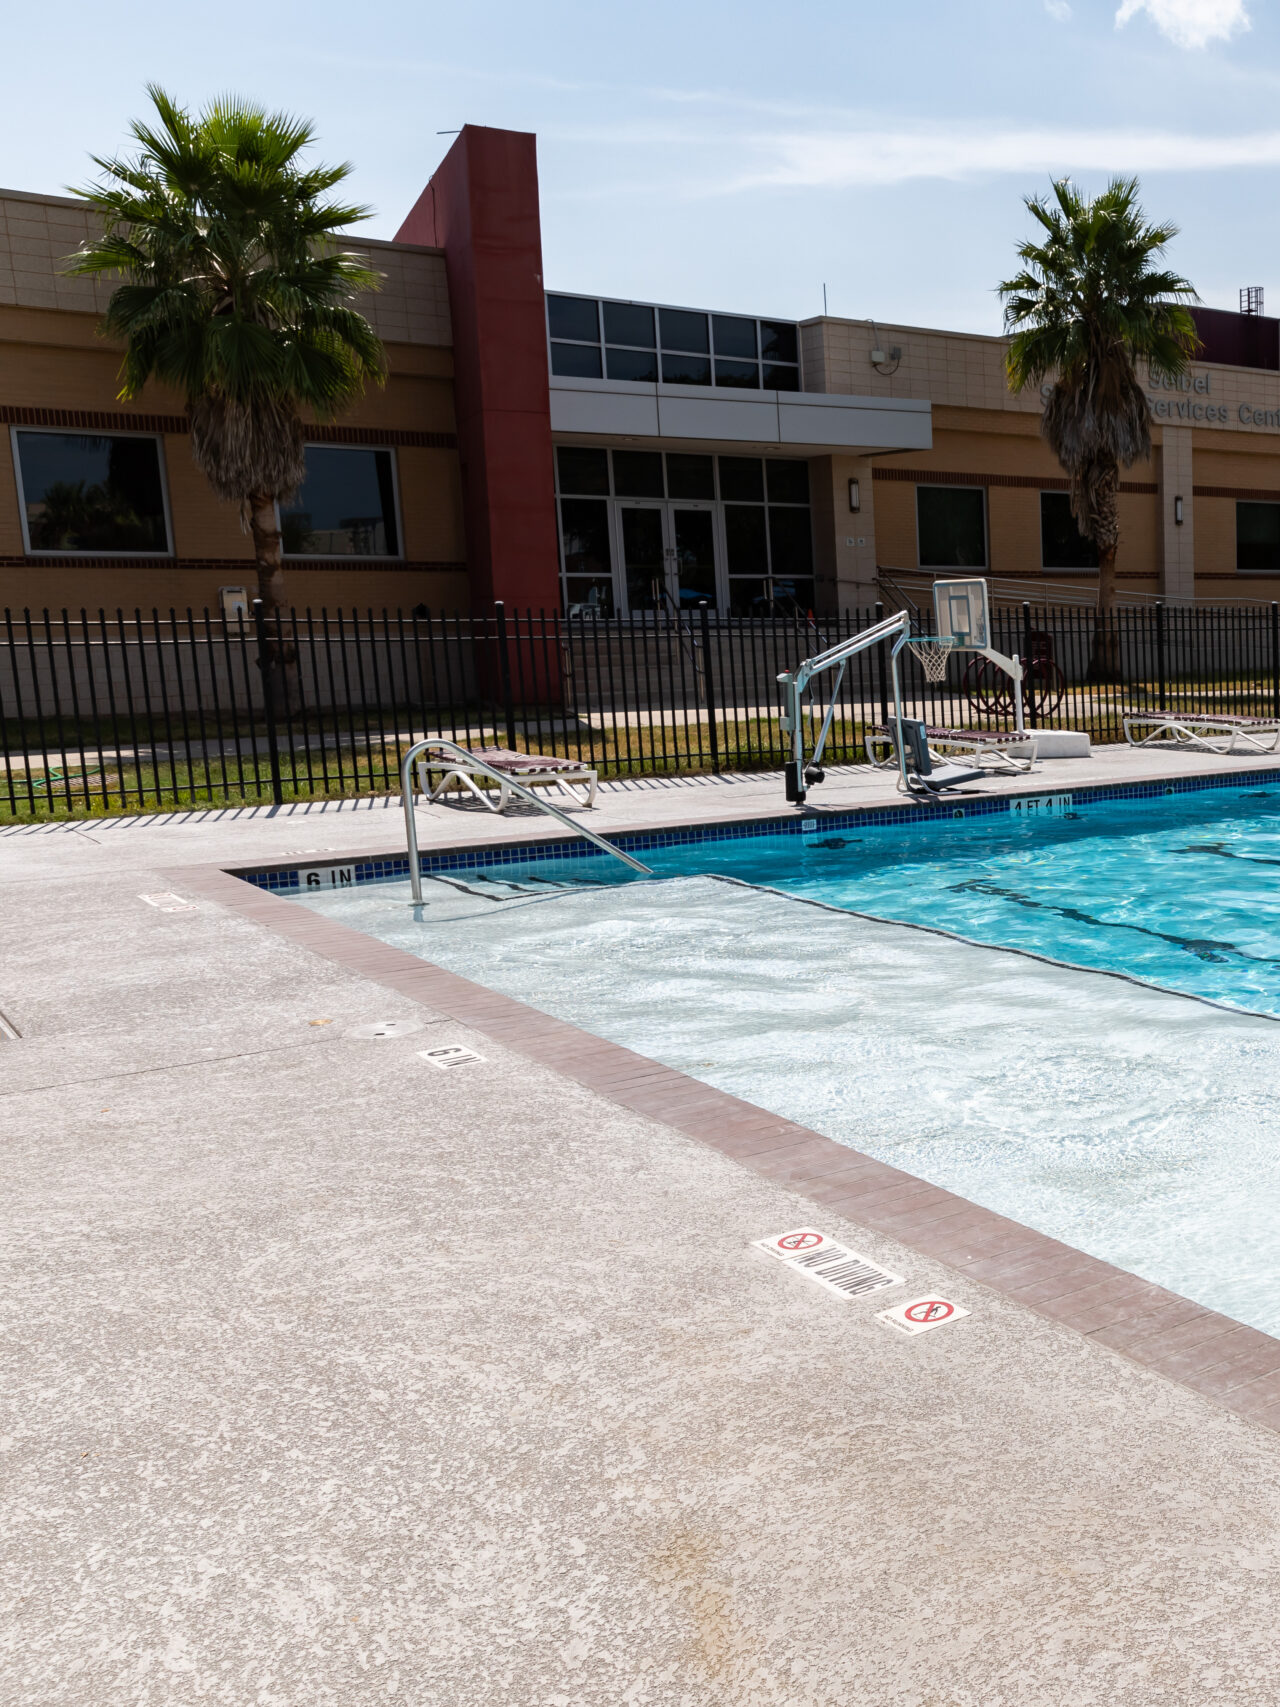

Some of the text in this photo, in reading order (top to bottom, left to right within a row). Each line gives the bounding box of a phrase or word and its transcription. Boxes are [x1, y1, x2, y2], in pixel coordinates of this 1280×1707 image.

[1027, 799, 1041, 813] FT
[1058, 796, 1071, 811] IN
[306, 868, 352, 887] 6 IN
[427, 1047, 482, 1068] 6 IN
[793, 1245, 894, 1296] NO DIVING
